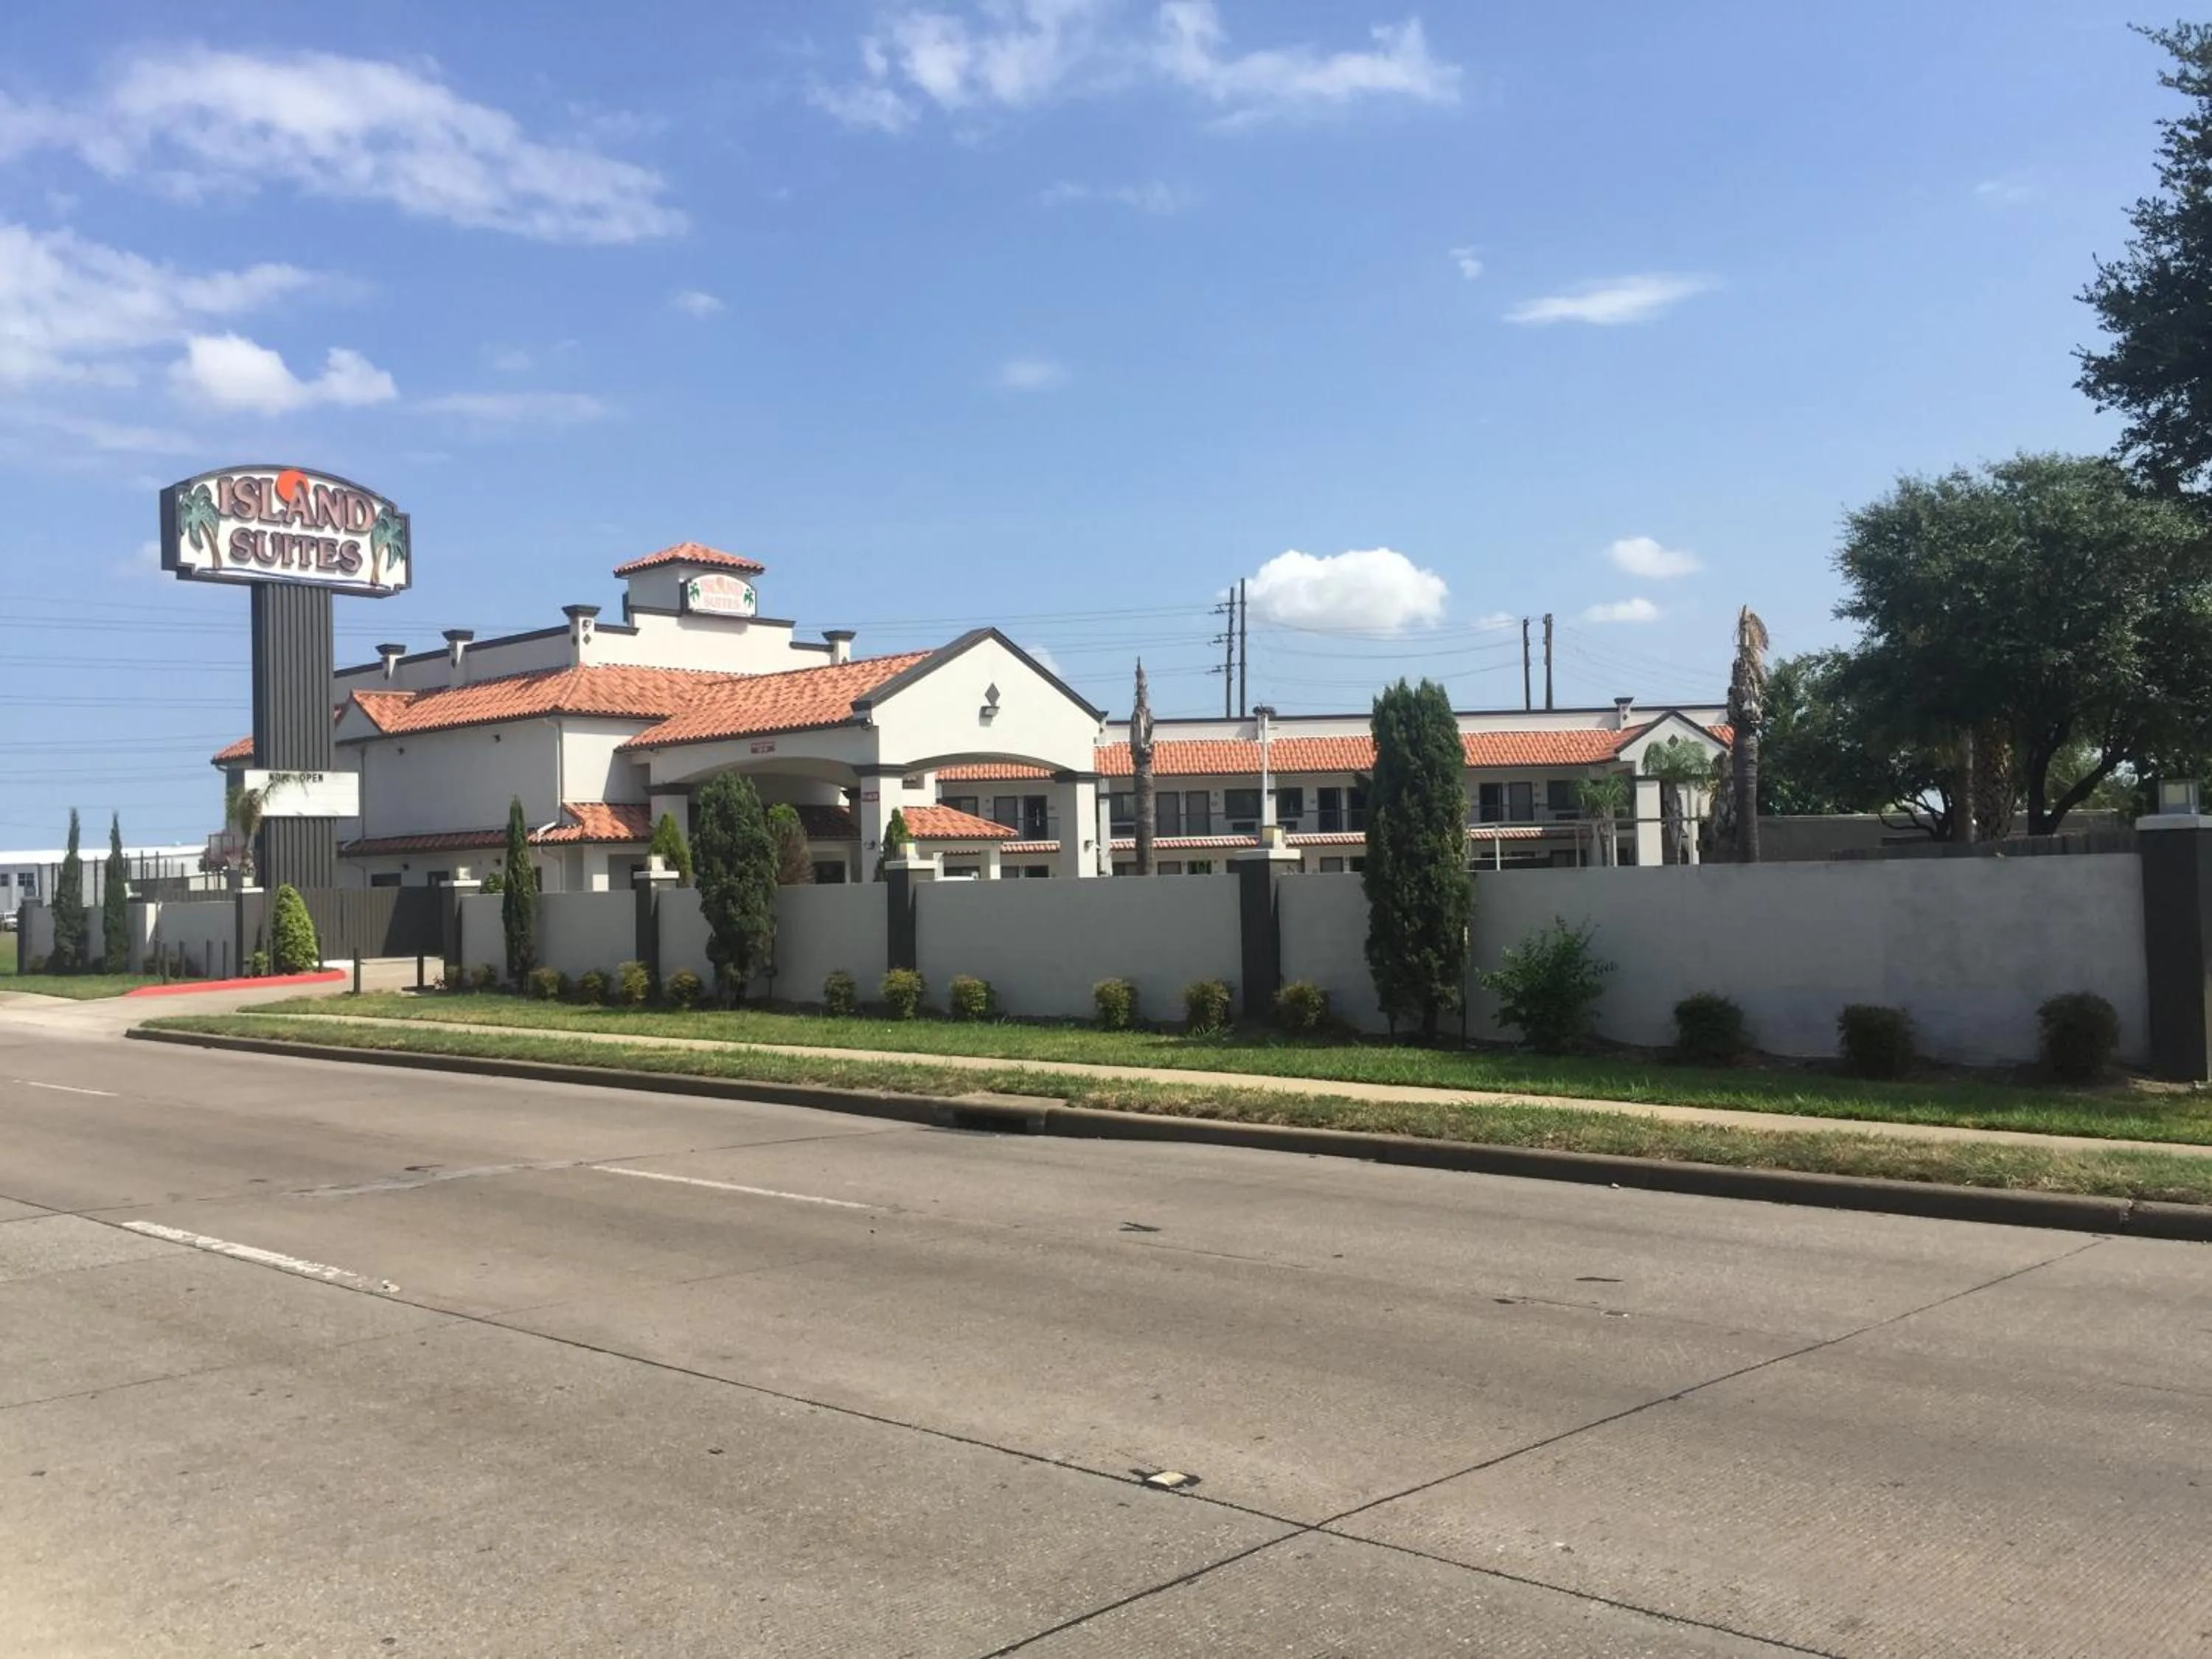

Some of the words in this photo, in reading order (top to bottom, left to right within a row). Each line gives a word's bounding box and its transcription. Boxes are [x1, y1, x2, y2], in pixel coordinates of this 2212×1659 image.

[218, 476, 376, 535] ISLAND
[230, 527, 364, 575] SUITES
[268, 772, 294, 782] NO
[299, 773, 324, 783] OPEN
